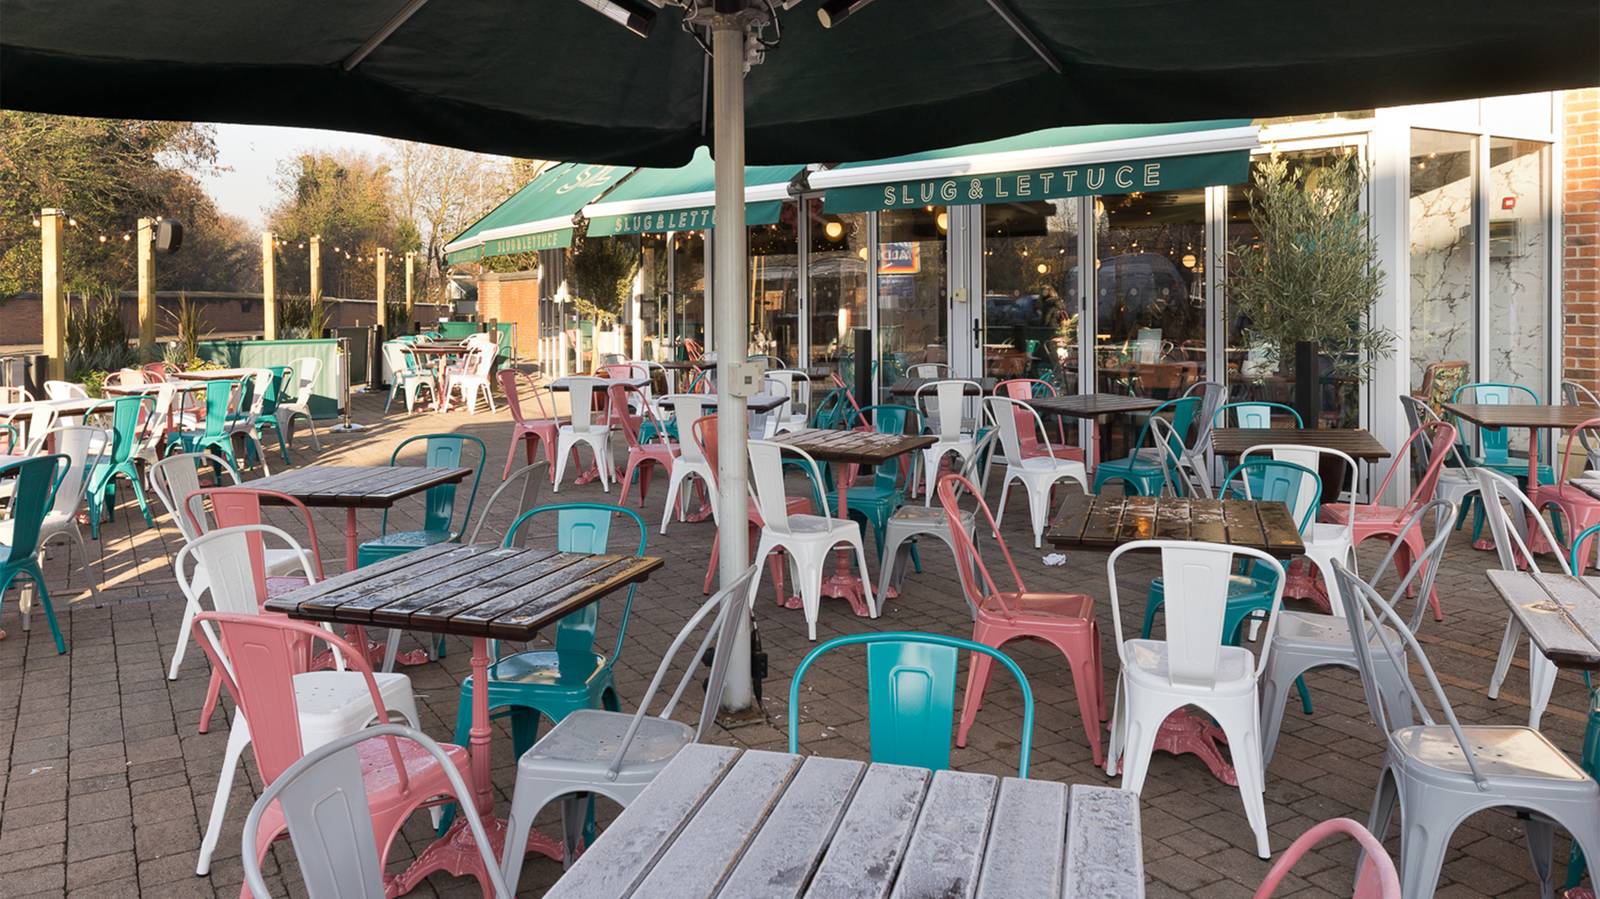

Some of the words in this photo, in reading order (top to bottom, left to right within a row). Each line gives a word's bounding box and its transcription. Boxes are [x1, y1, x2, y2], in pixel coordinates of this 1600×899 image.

[884, 180, 957, 206] SLUG
[968, 178, 984, 200] &
[995, 163, 1161, 198] LETTUCE
